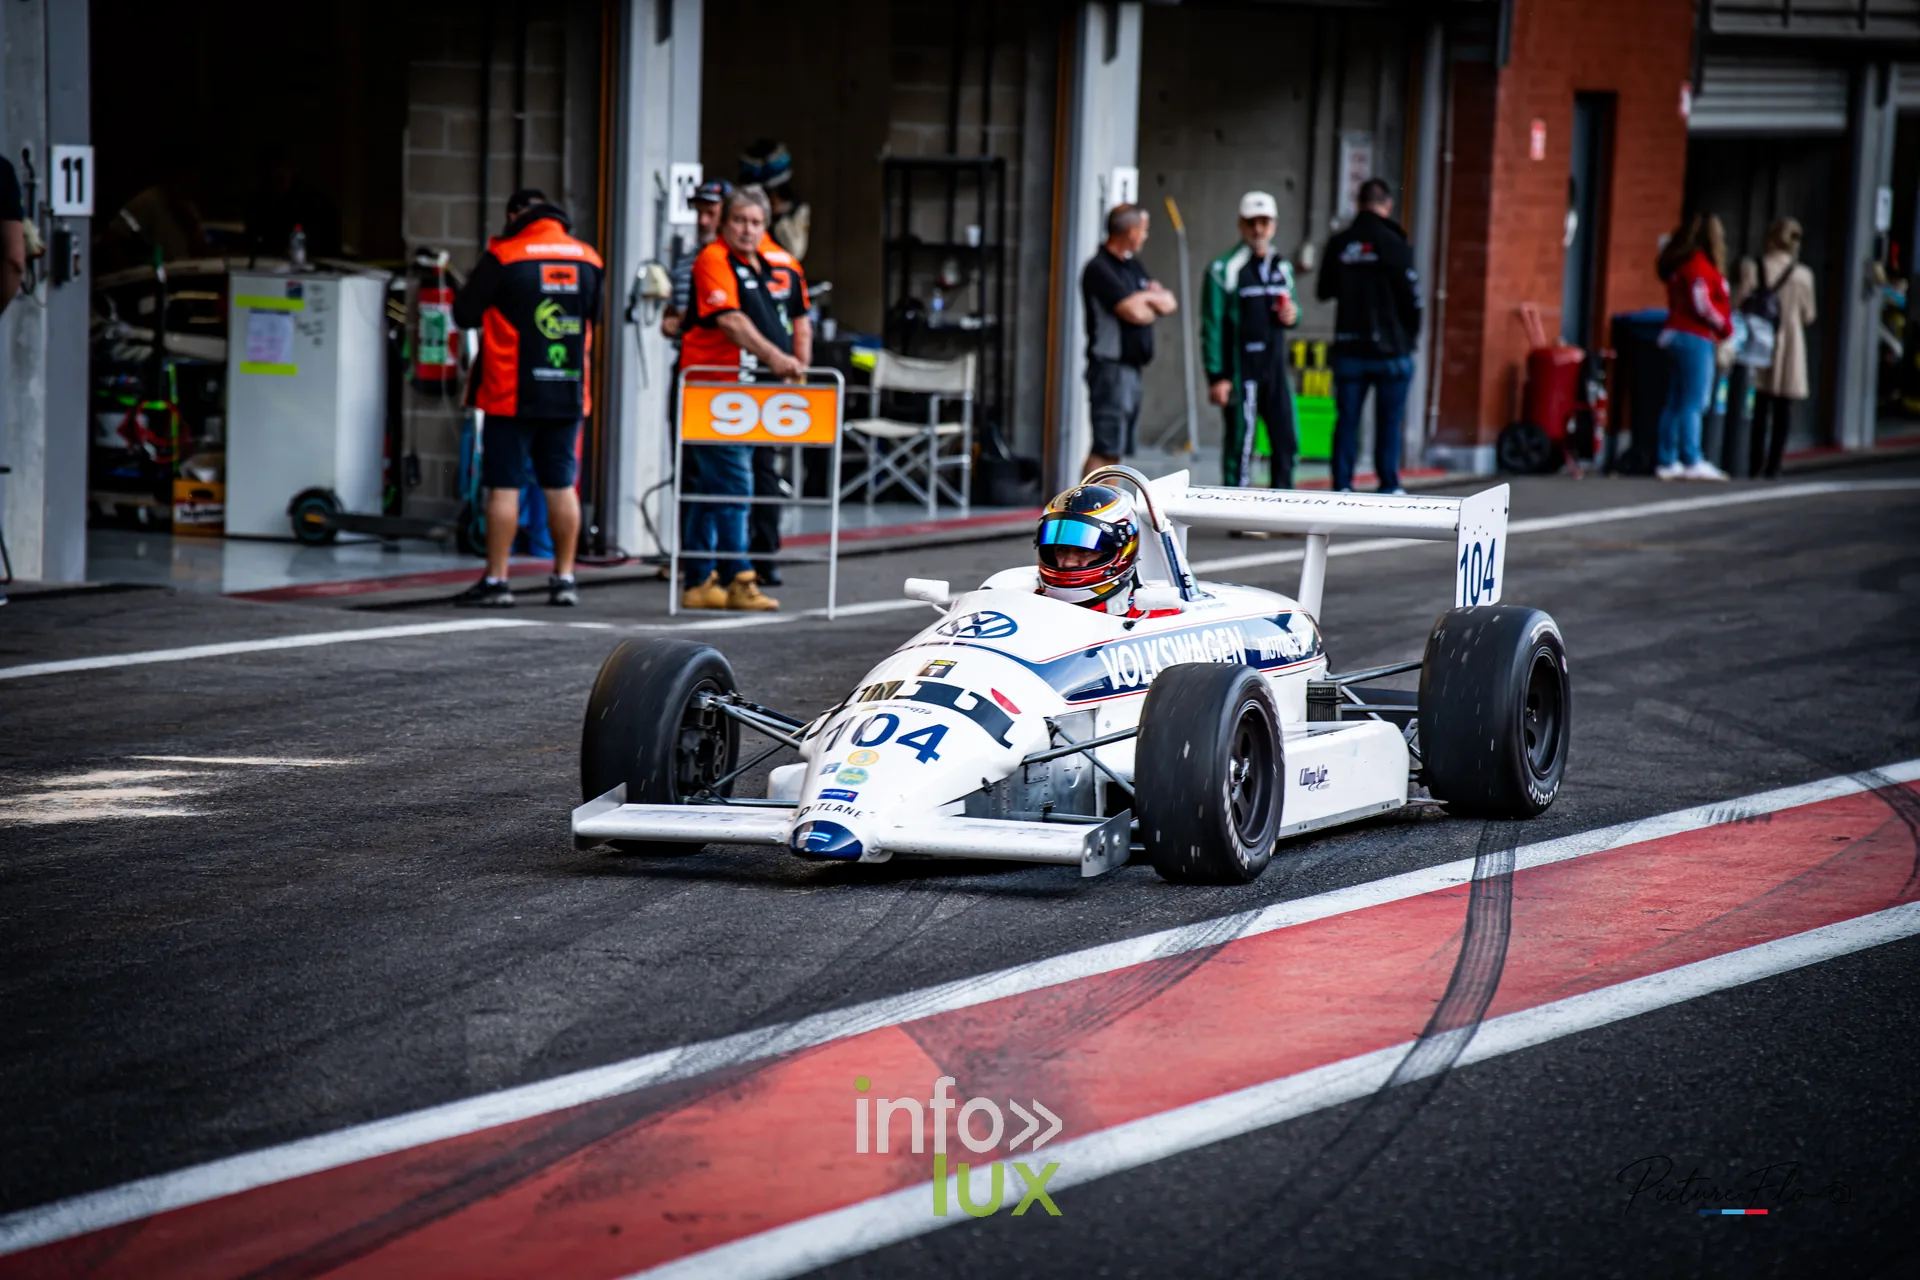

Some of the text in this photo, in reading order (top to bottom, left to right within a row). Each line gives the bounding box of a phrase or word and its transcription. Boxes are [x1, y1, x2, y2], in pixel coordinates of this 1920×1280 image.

[60, 156, 84, 204] 11
[709, 391, 812, 437] 96
[1460, 537, 1496, 607] 104
[1096, 626, 1248, 690] VOLKSWAGEN
[823, 713, 951, 765] 104
